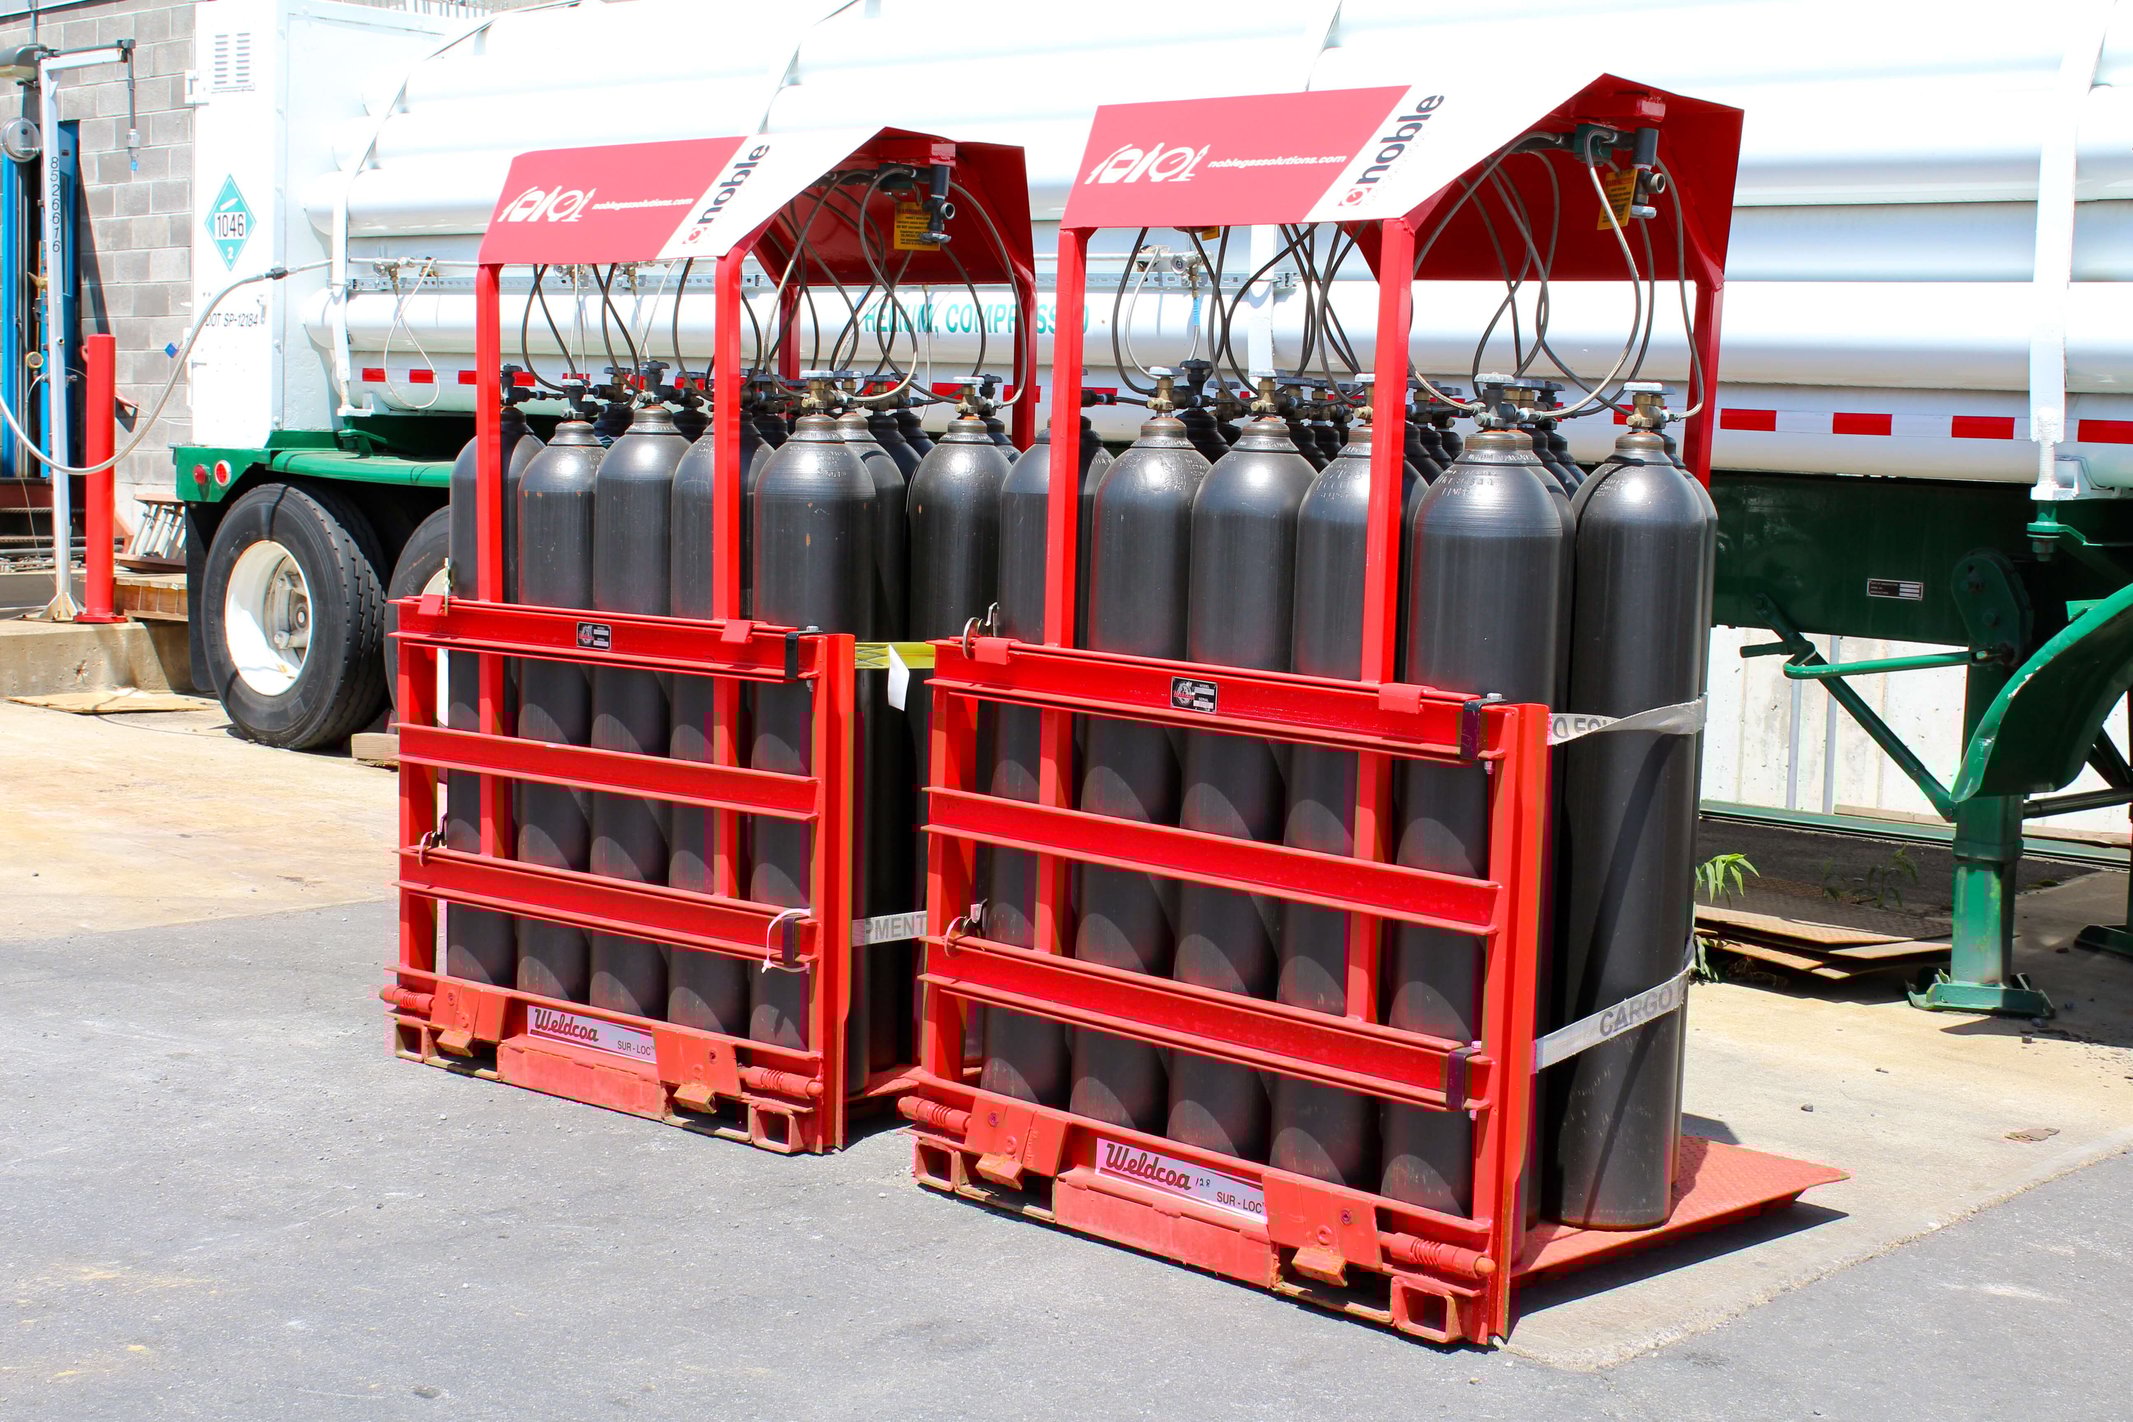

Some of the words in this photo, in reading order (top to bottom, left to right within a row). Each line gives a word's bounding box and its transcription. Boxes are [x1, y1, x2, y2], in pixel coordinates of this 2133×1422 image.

[1355, 95, 1445, 184] noble
[1208, 155, 1347, 168] noblegassolutions.com
[696, 145, 770, 224] noble
[217, 214, 244, 237] 1046
[227, 246, 234, 259] 2
[534, 1008, 599, 1042] Weldcoa
[1600, 986, 1673, 1036] CARGO
[1106, 1143, 1191, 1190] Weldcoa
